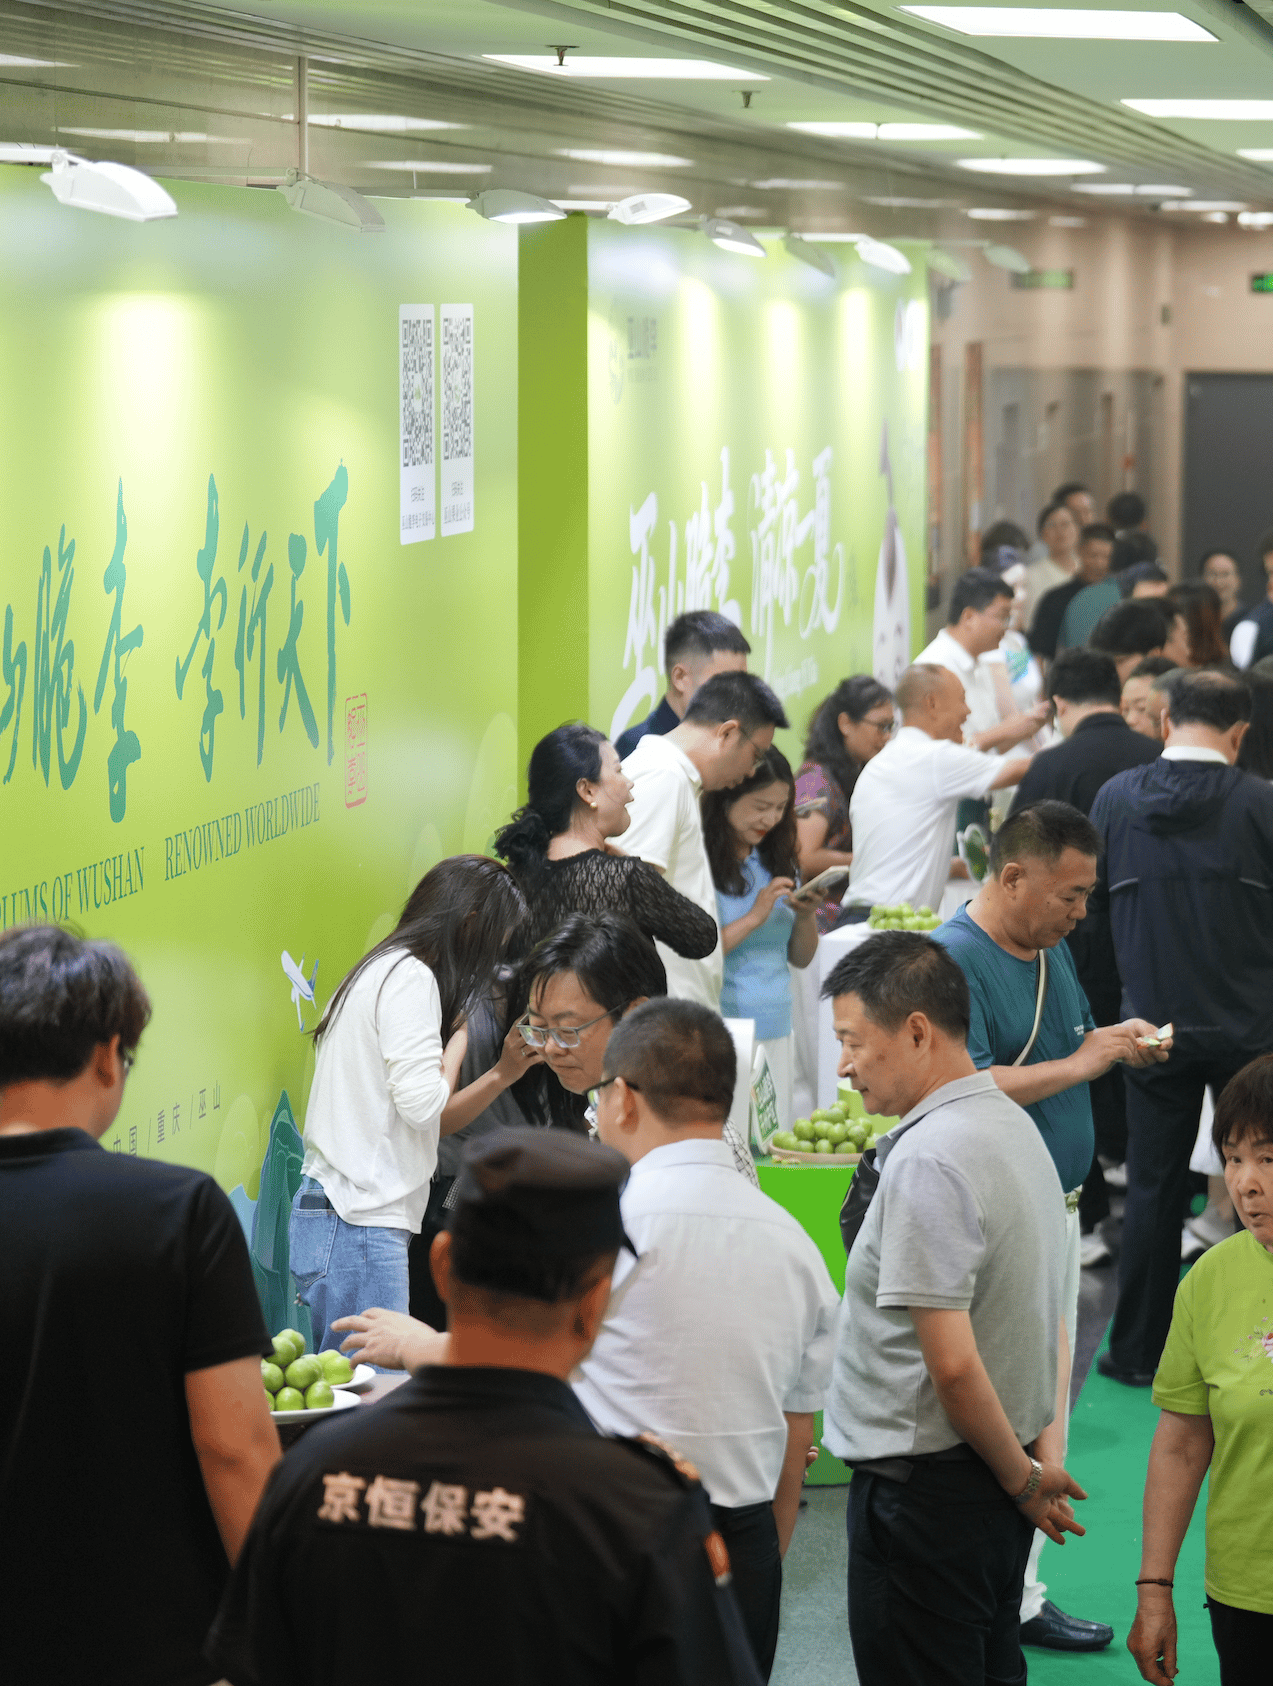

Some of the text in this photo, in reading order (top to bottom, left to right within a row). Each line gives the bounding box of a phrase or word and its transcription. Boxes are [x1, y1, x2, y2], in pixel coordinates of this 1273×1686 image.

[0, 782, 320, 930] LUMS OF WUSHAN RENOWNED WORLDWIDE
[317, 1470, 526, 1542] 京恒保安
